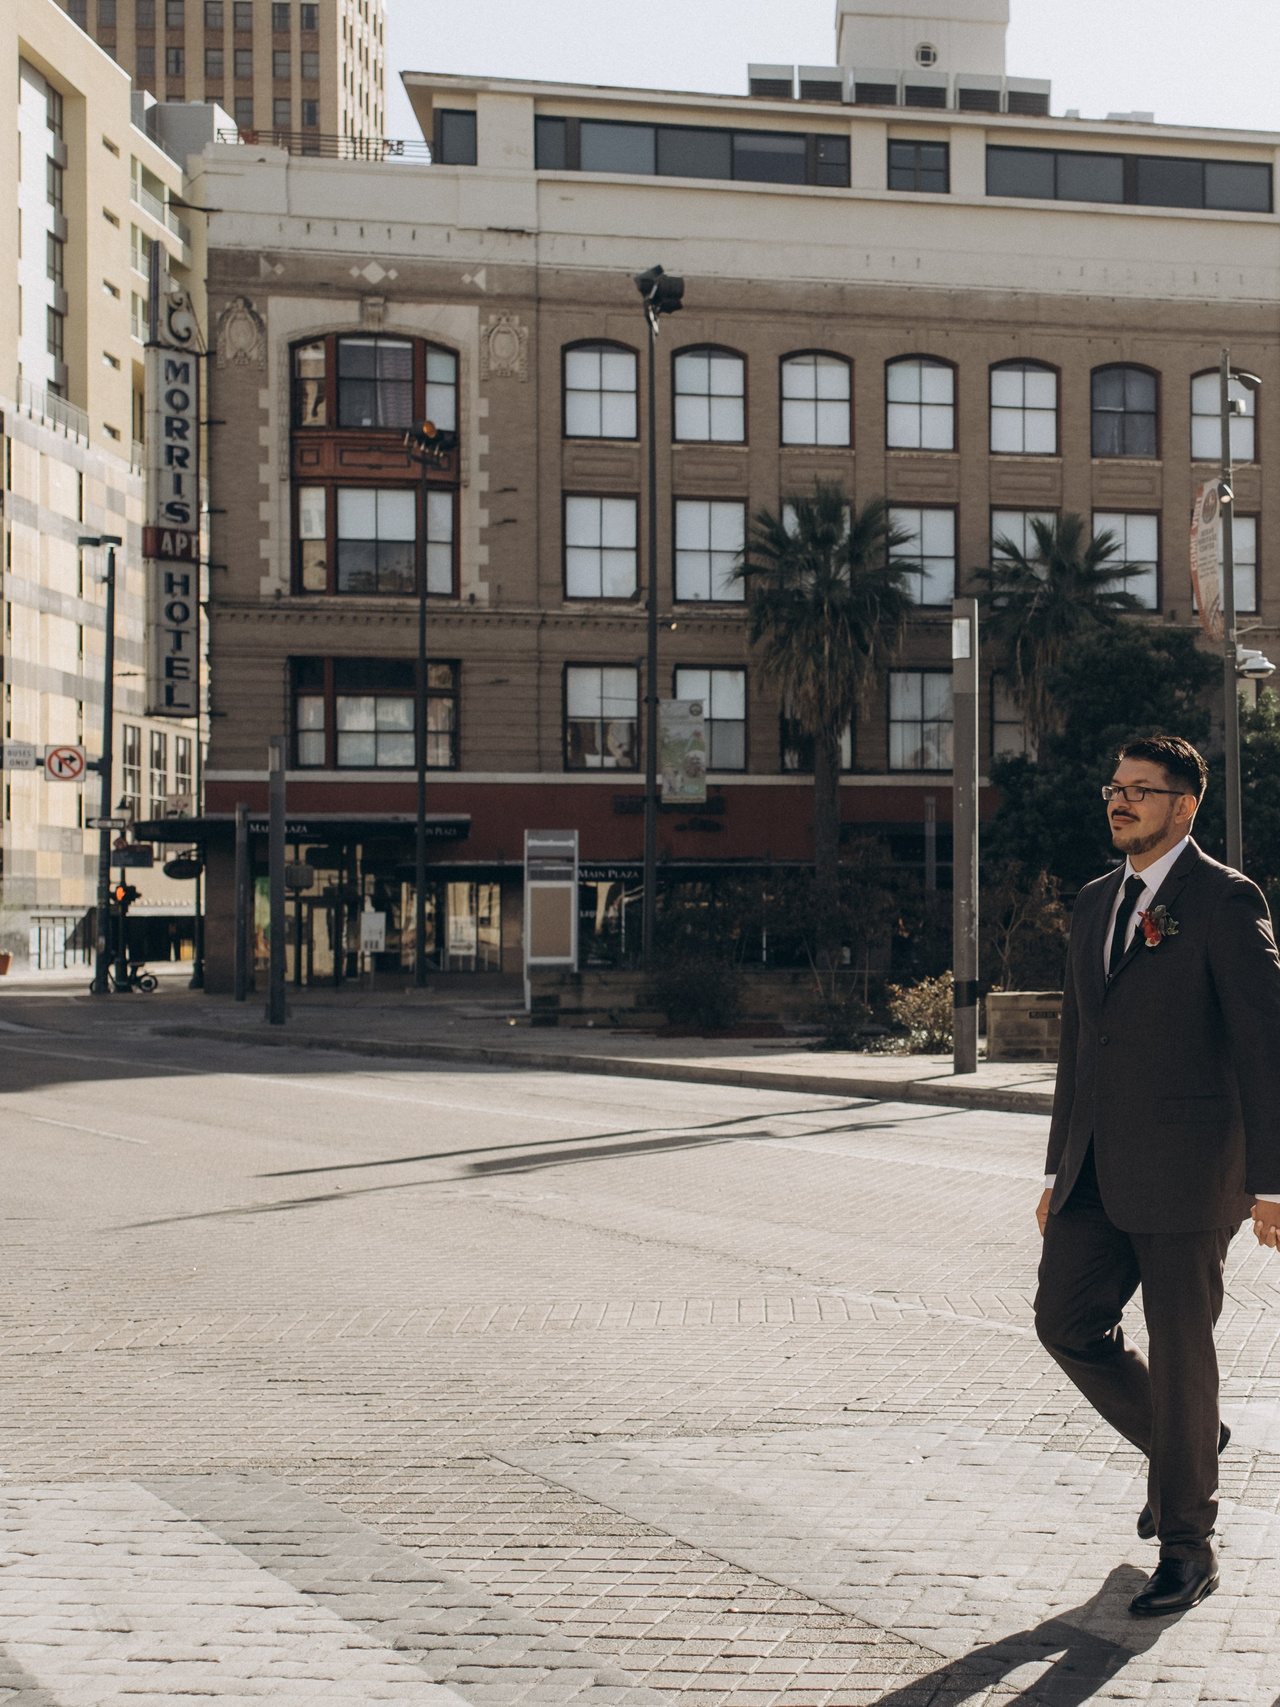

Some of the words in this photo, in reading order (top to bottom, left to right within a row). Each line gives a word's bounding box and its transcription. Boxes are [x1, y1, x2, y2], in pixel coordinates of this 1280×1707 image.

[164, 359, 190, 524] MORRIS
[164, 571, 190, 708] HOTEL
[7, 749, 31, 757] BUSES
[250, 823, 270, 834] MAI
[608, 869, 639, 879] PLAZA
